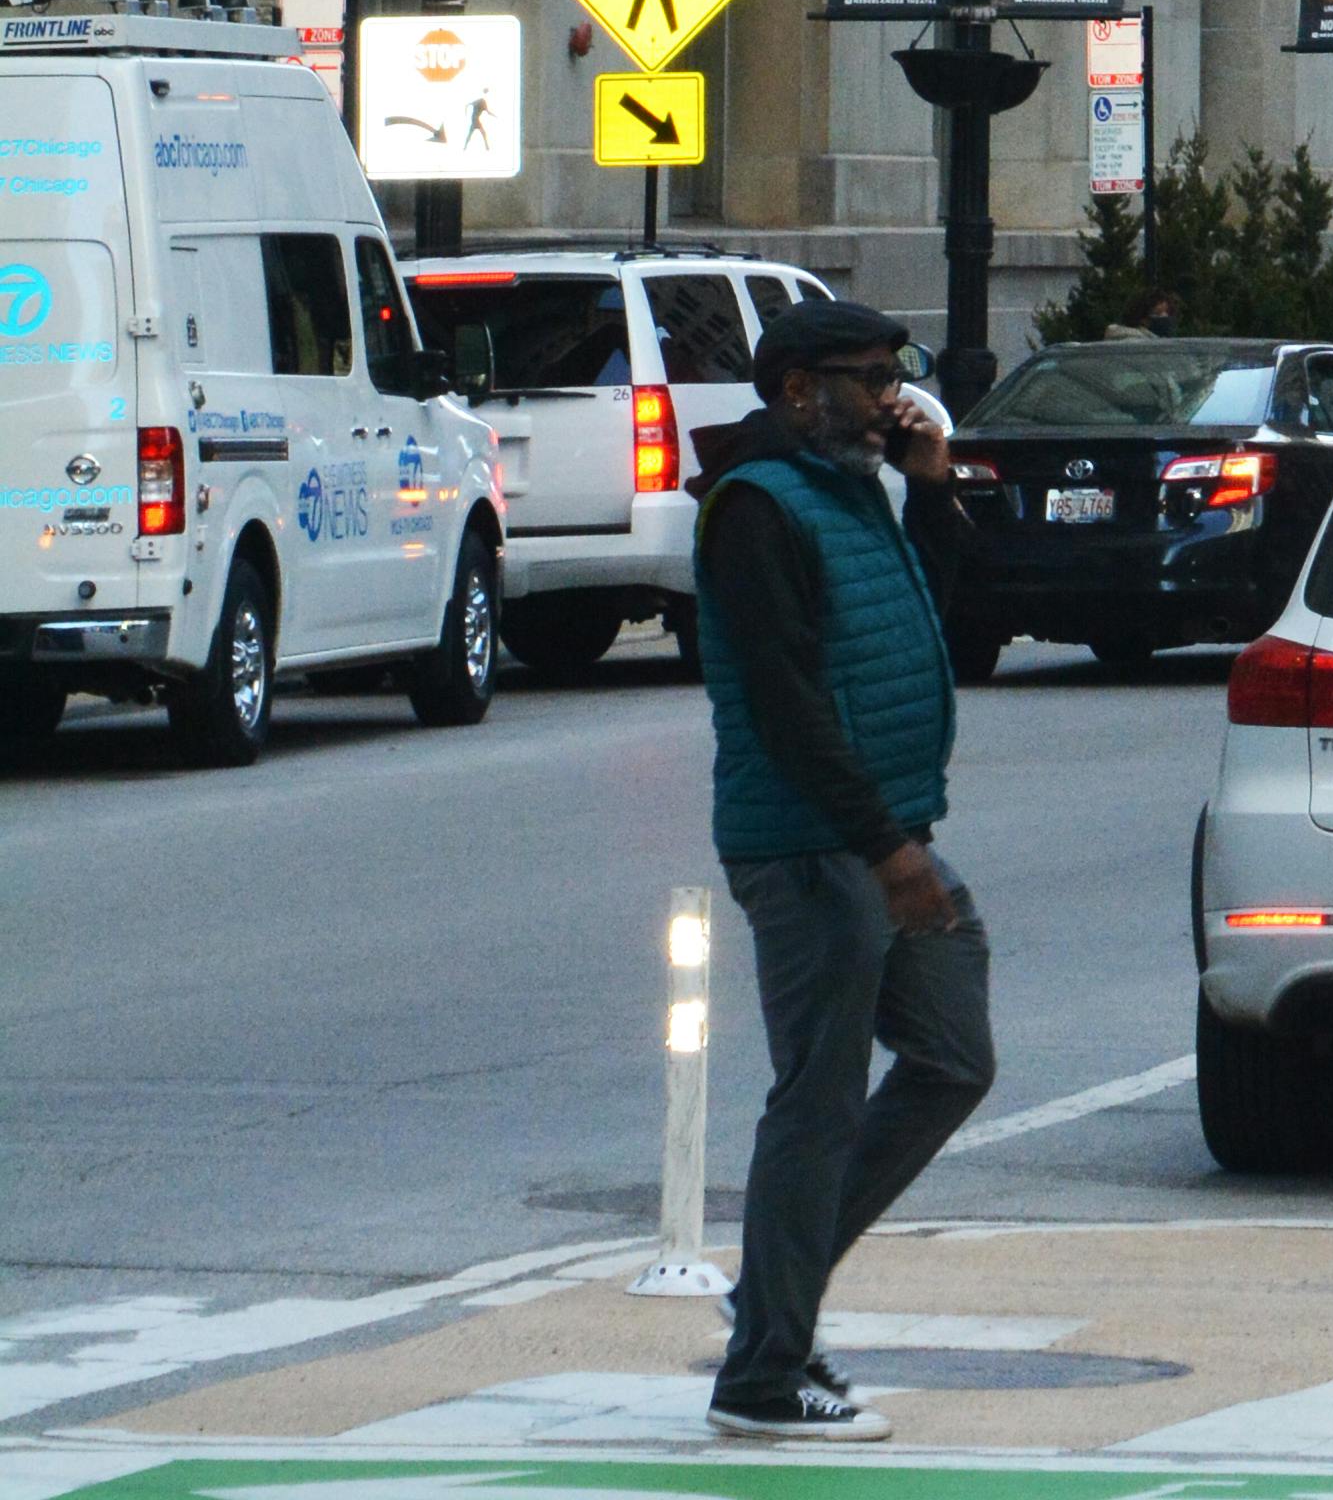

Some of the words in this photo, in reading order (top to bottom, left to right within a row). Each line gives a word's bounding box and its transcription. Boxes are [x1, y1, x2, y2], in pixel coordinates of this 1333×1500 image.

[4, 19, 93, 38] FRONTLINE
[94, 28, 115, 37] abc
[311, 29, 339, 42] ZONE
[414, 43, 467, 69] STOP
[1092, 75, 1111, 85] TOW
[1114, 75, 1139, 85] ZONE
[153, 134, 249, 176] abc7chicago.com
[9, 177, 89, 196] Chicago
[47, 342, 114, 363] NEWS
[613, 388, 630, 402] 26
[109, 397, 126, 420] 2
[323, 487, 369, 540] NEWS
